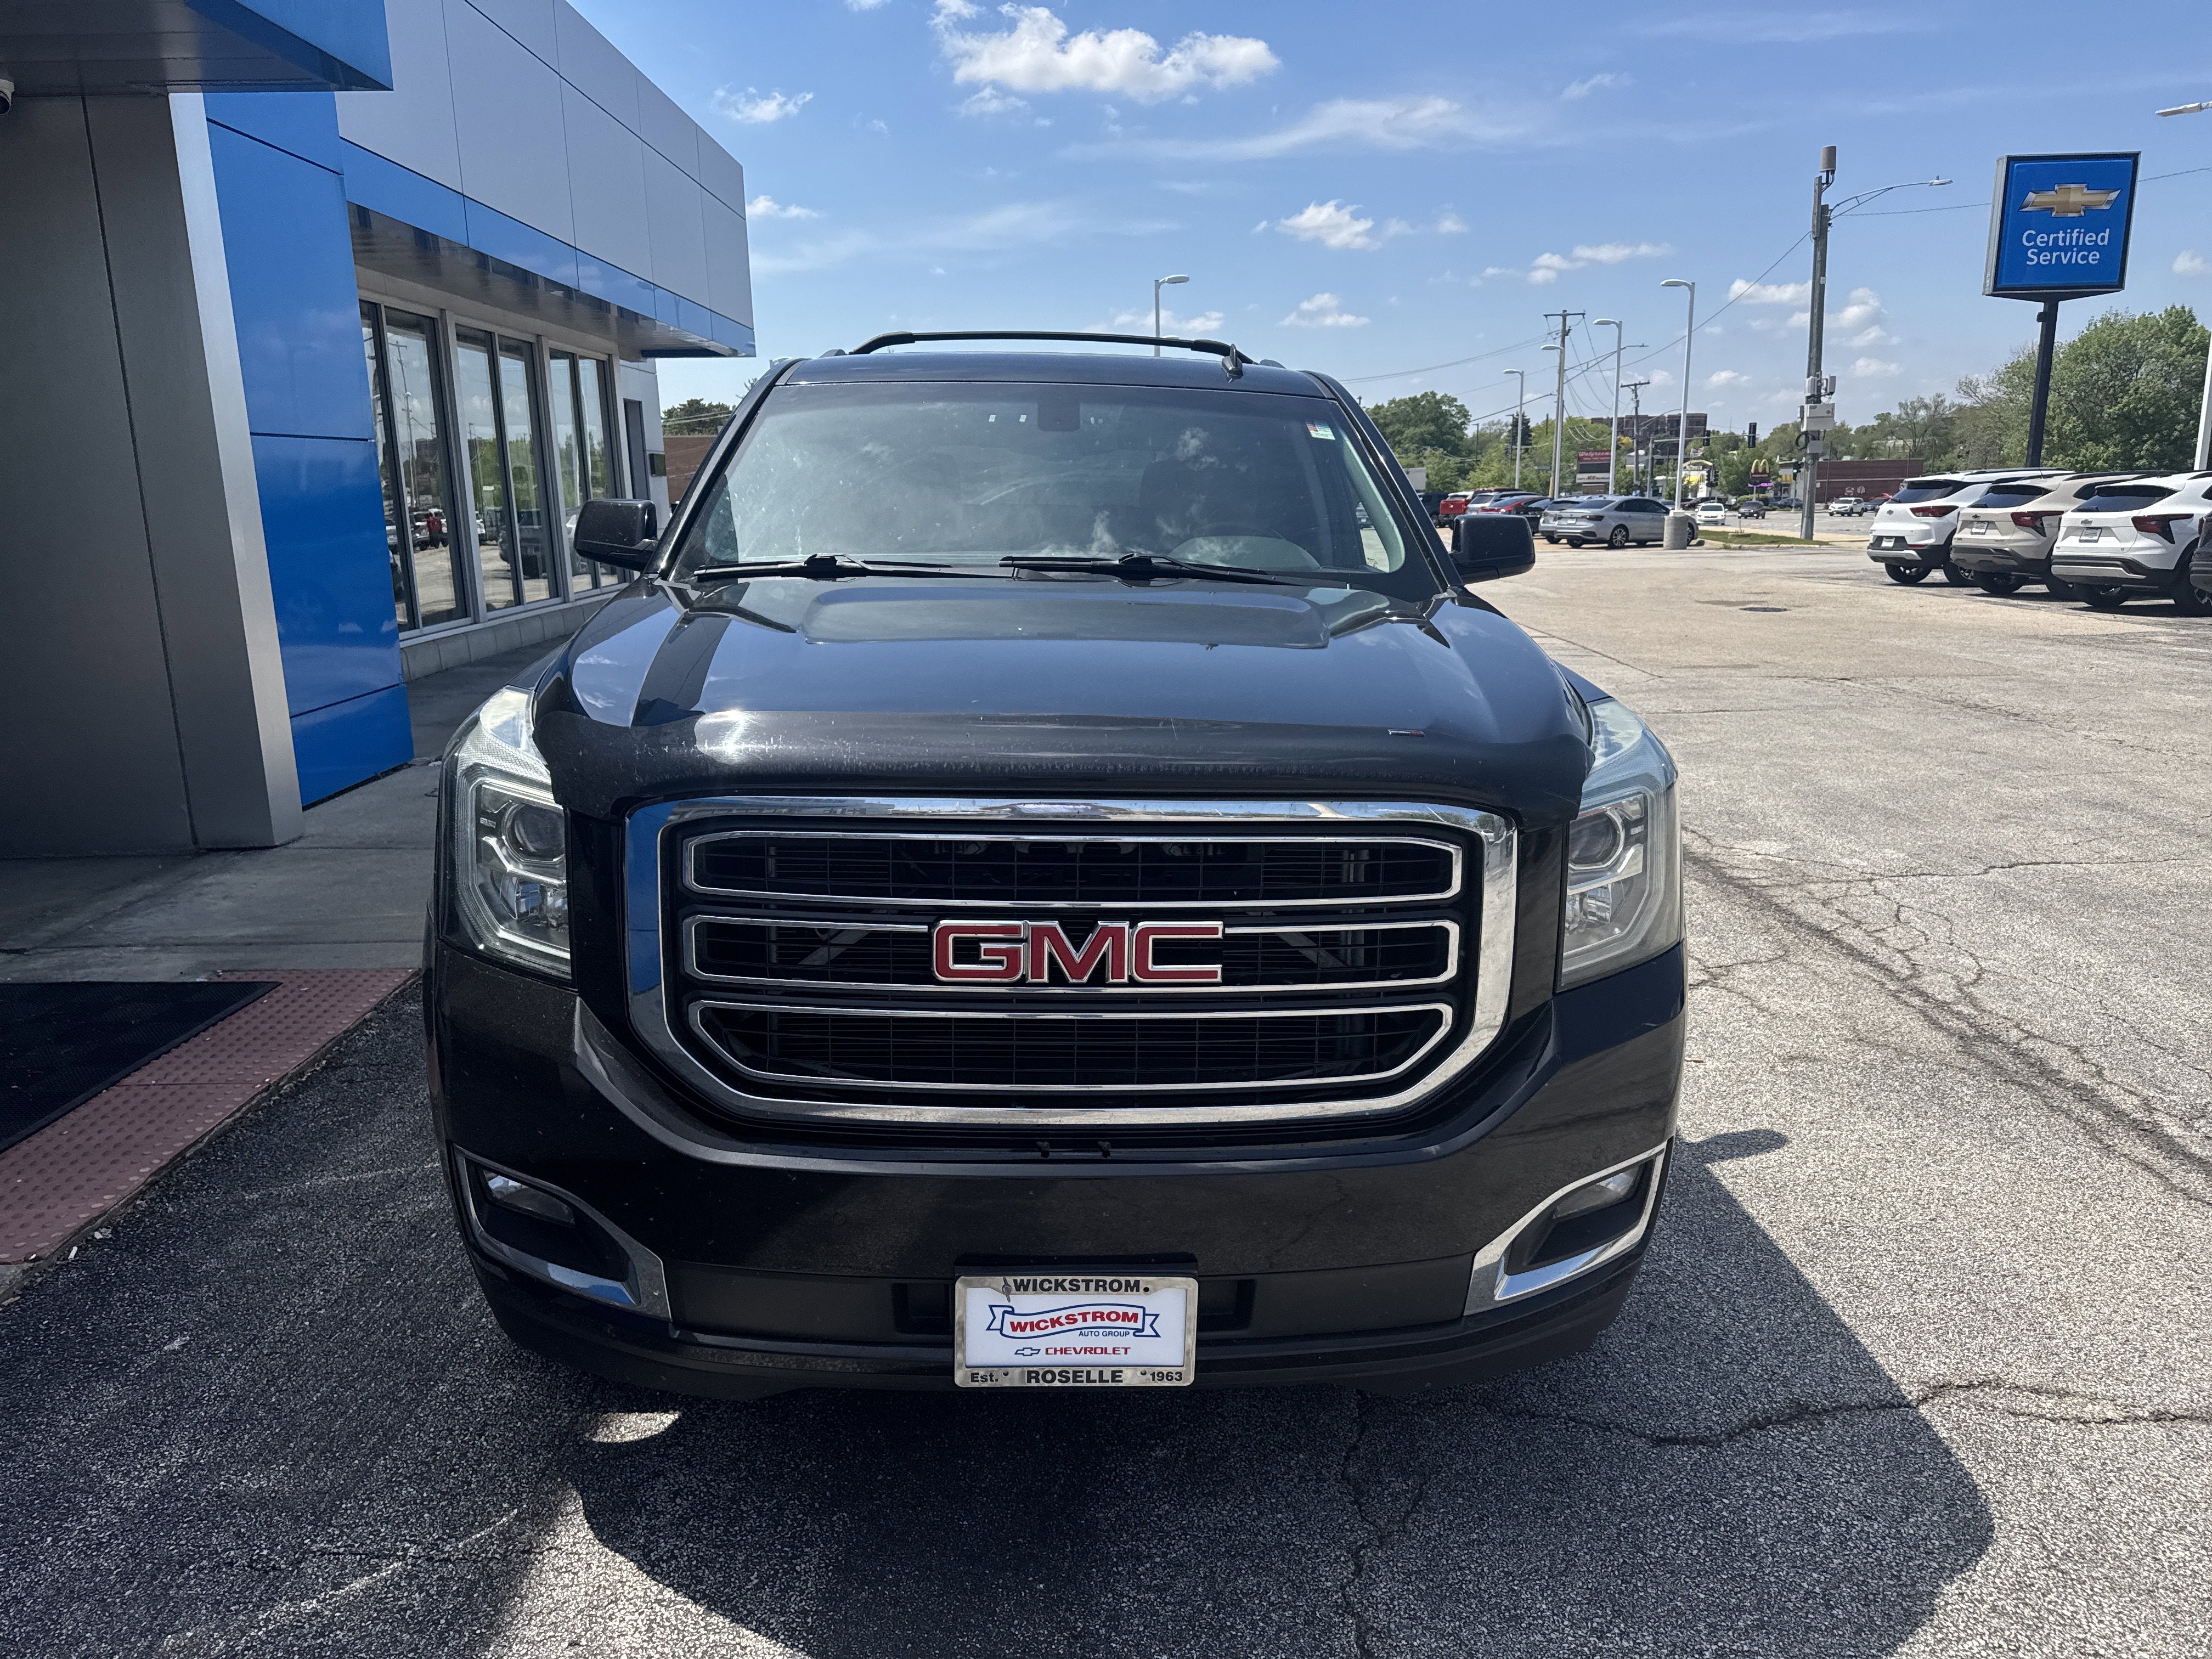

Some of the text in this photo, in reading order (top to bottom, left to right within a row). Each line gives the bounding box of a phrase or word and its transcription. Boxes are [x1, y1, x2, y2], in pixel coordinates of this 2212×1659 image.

[2022, 228, 2109, 246] Certified
[2026, 247, 2100, 265] Service
[933, 919, 1224, 984] GMC
[1013, 1278, 1141, 1293] WICKSTROM
[1009, 1311, 1139, 1332] WICKSTROM
[1045, 1346, 1131, 1355] CHEVROLET
[970, 1369, 1183, 1383] Est. ROSELLE 1963
